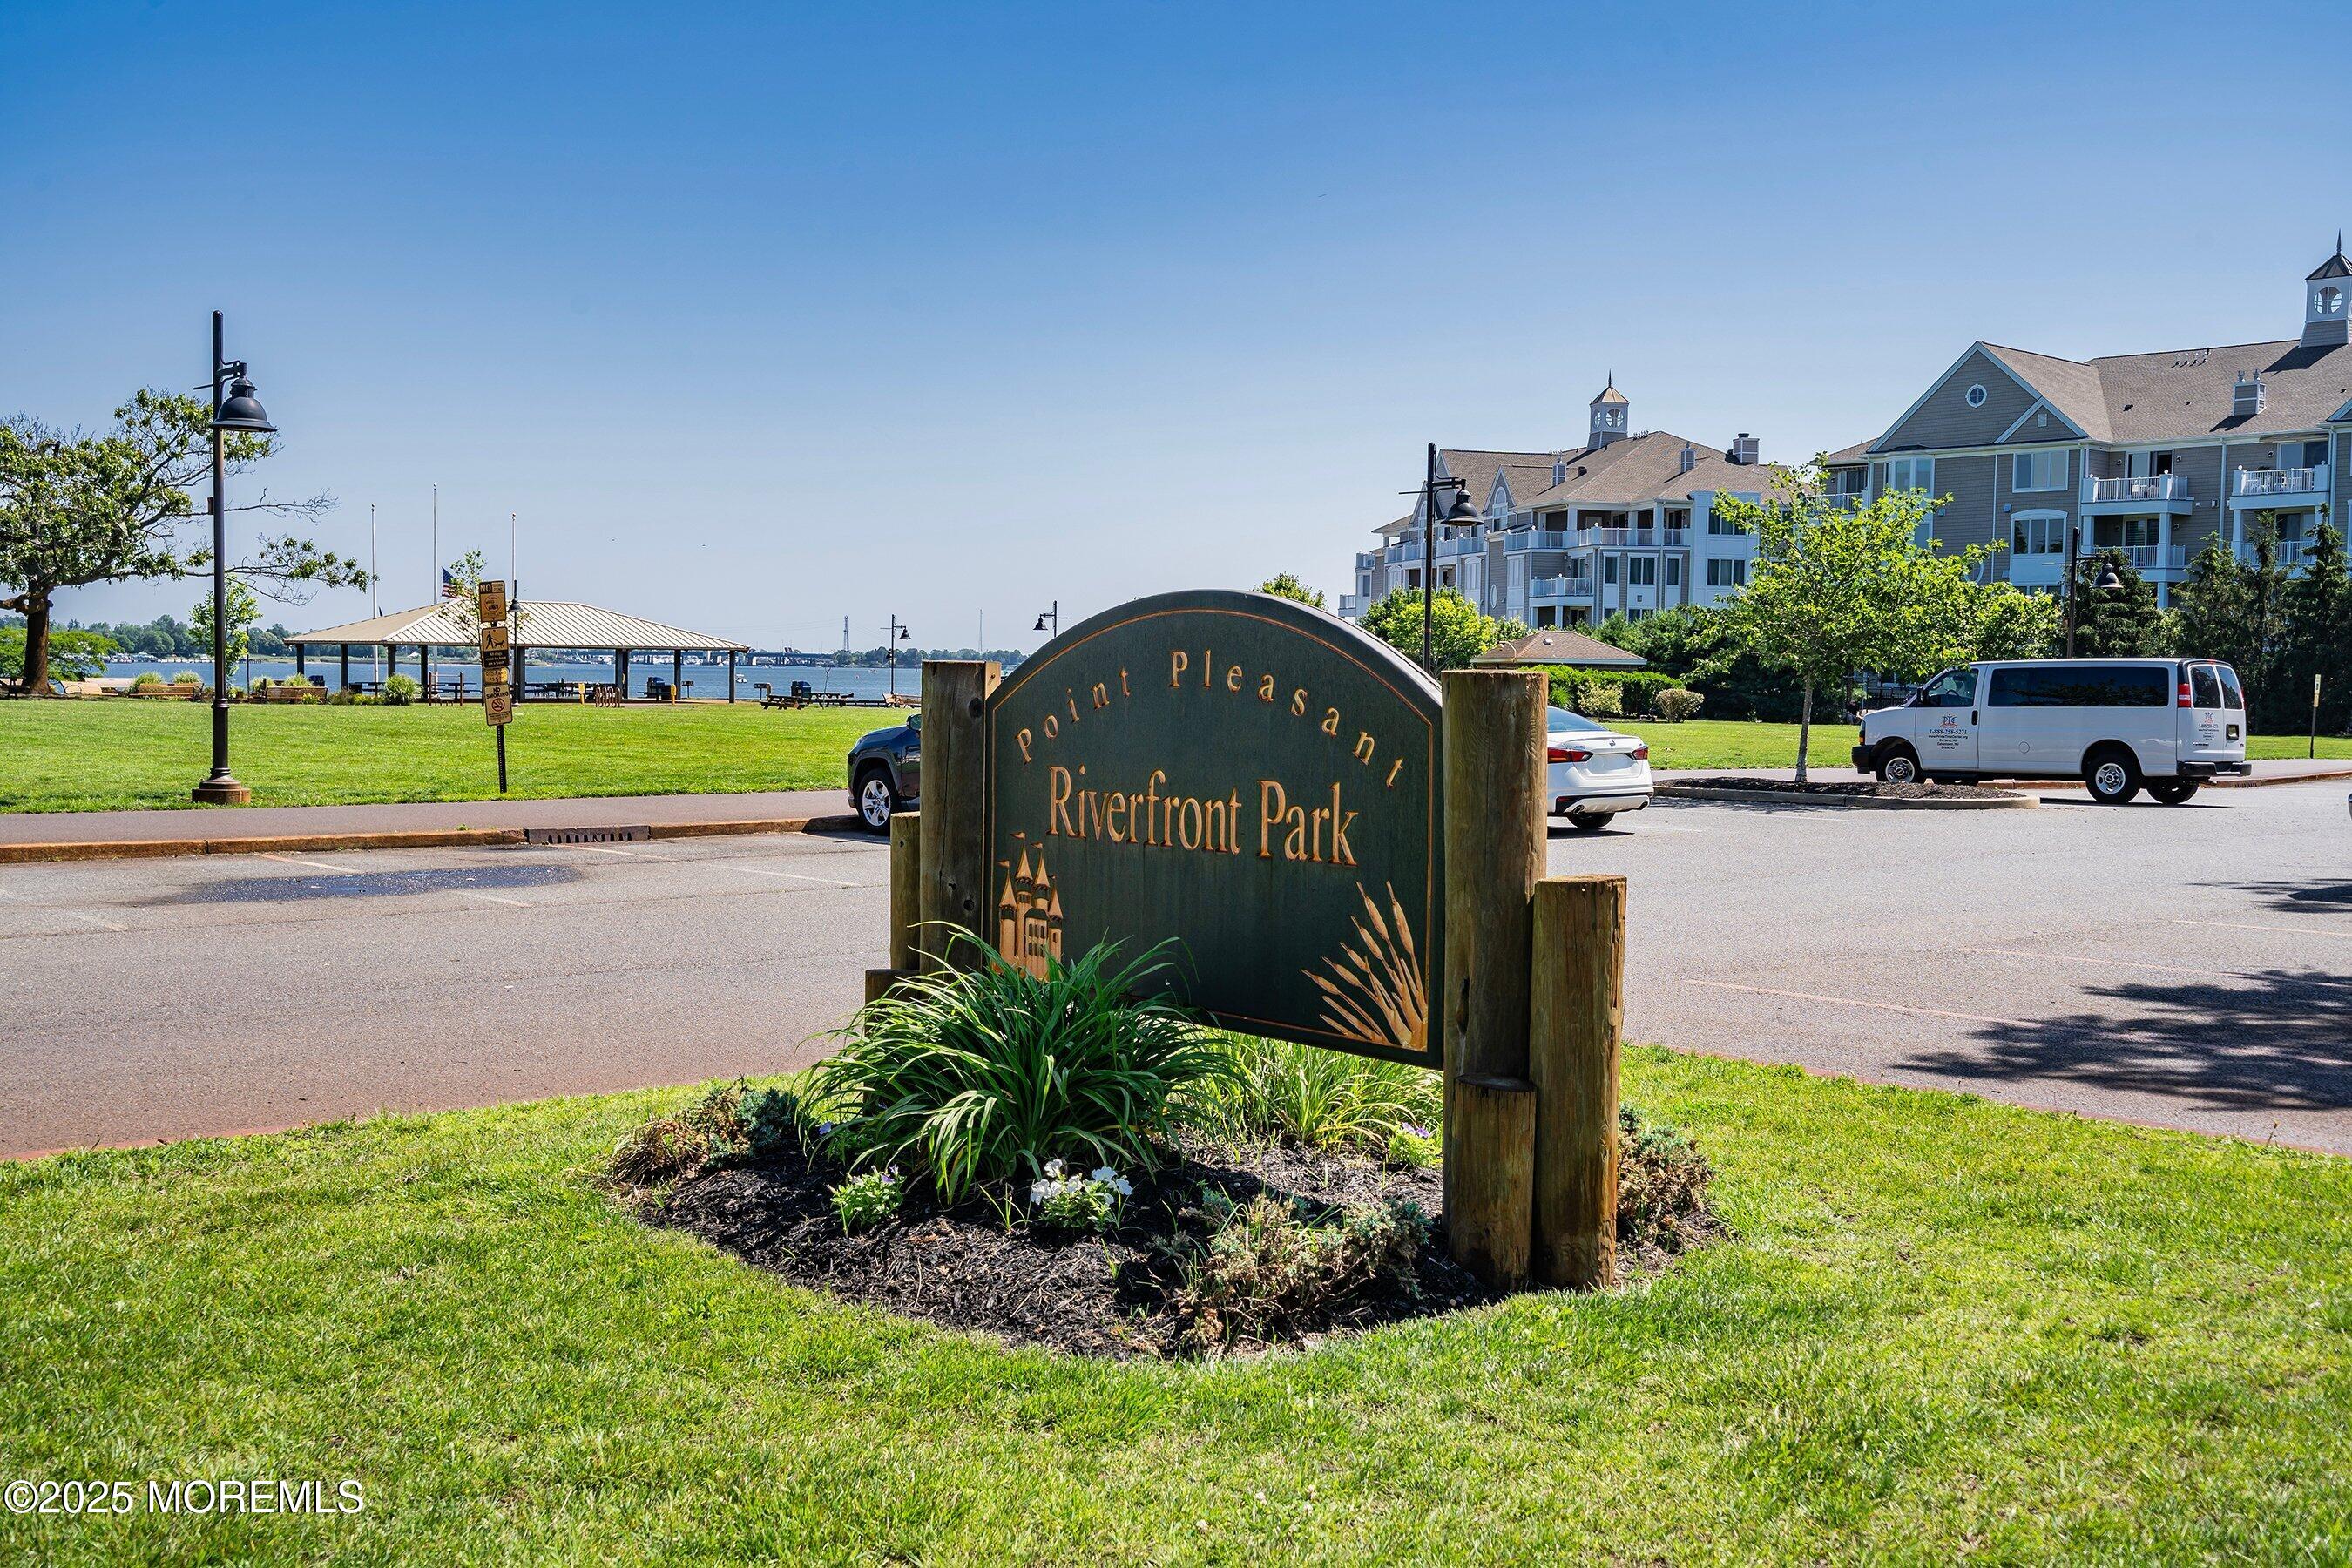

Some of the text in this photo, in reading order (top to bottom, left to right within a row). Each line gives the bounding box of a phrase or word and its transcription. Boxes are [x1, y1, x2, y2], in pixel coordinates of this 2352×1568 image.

[480, 584, 491, 592] NO
[1015, 649, 1405, 788] Point Pleasant
[1047, 764, 1359, 867] Riverfront Park
